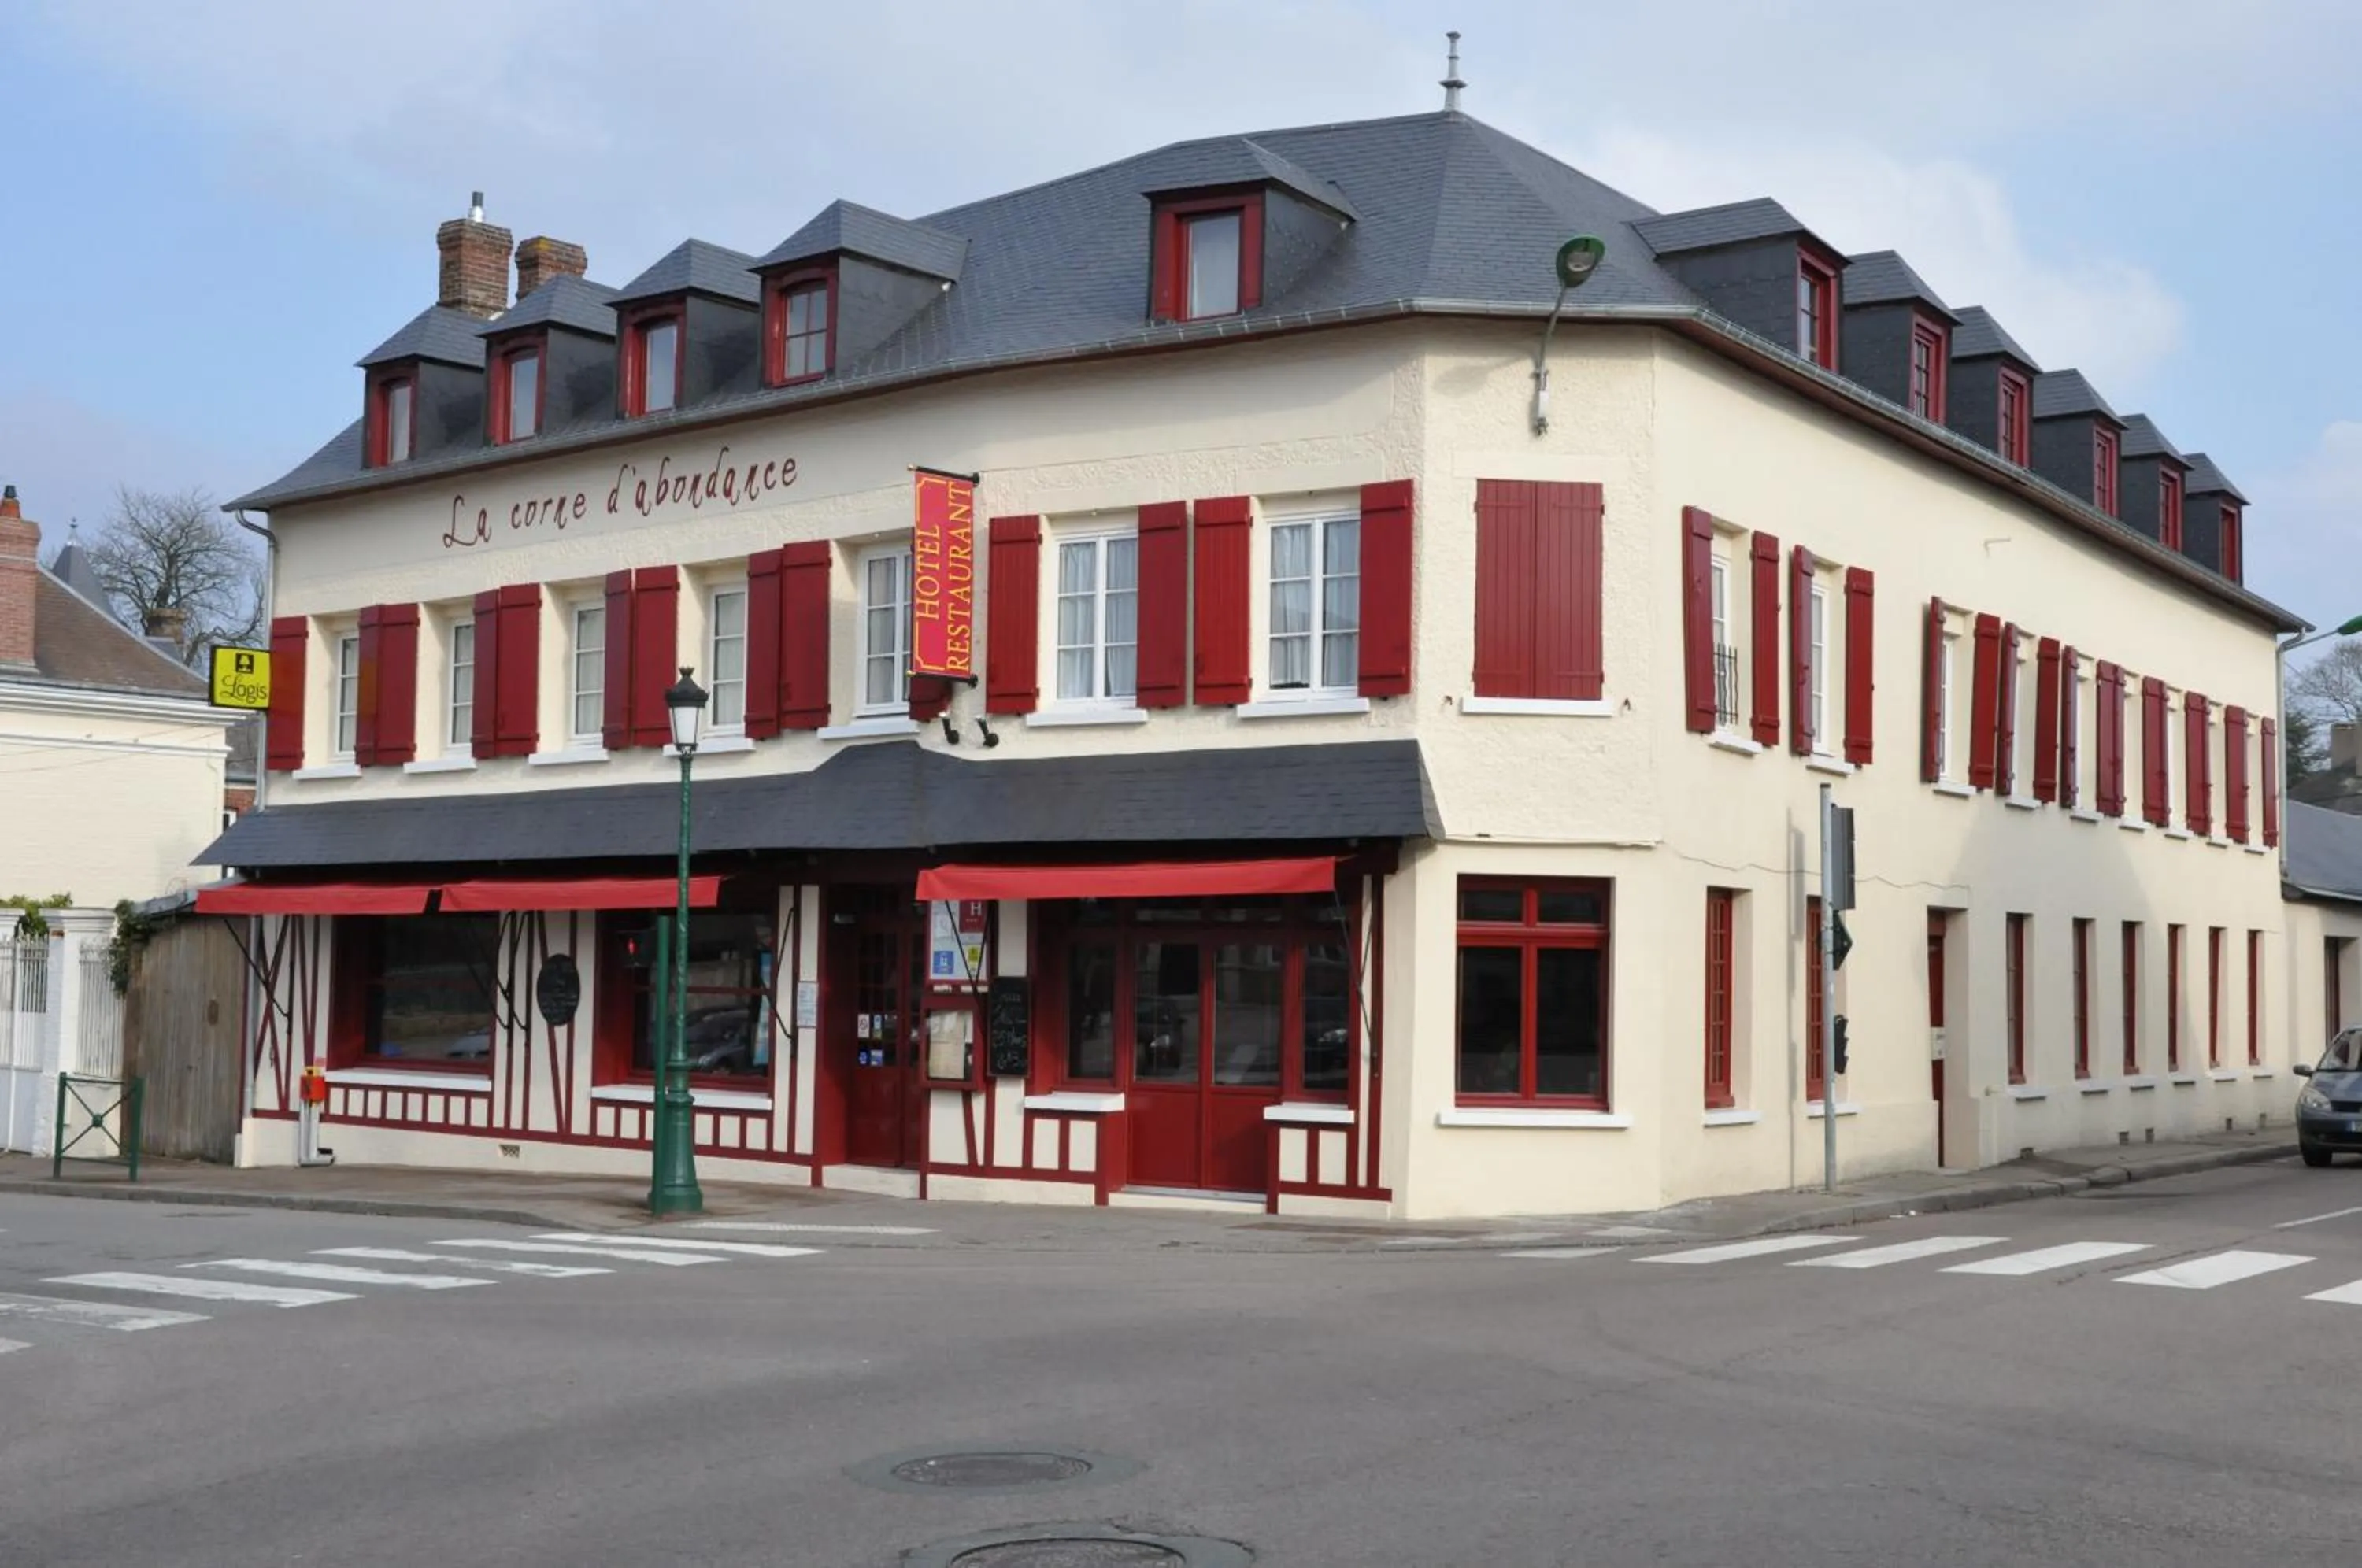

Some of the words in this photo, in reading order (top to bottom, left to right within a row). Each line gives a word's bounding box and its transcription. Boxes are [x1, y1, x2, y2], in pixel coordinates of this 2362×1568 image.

[442, 495, 493, 548] La
[511, 490, 587, 530] corne
[607, 446, 798, 517] d'abondance
[916, 523, 940, 620] HOTEL
[947, 481, 972, 671] RESTAURANT
